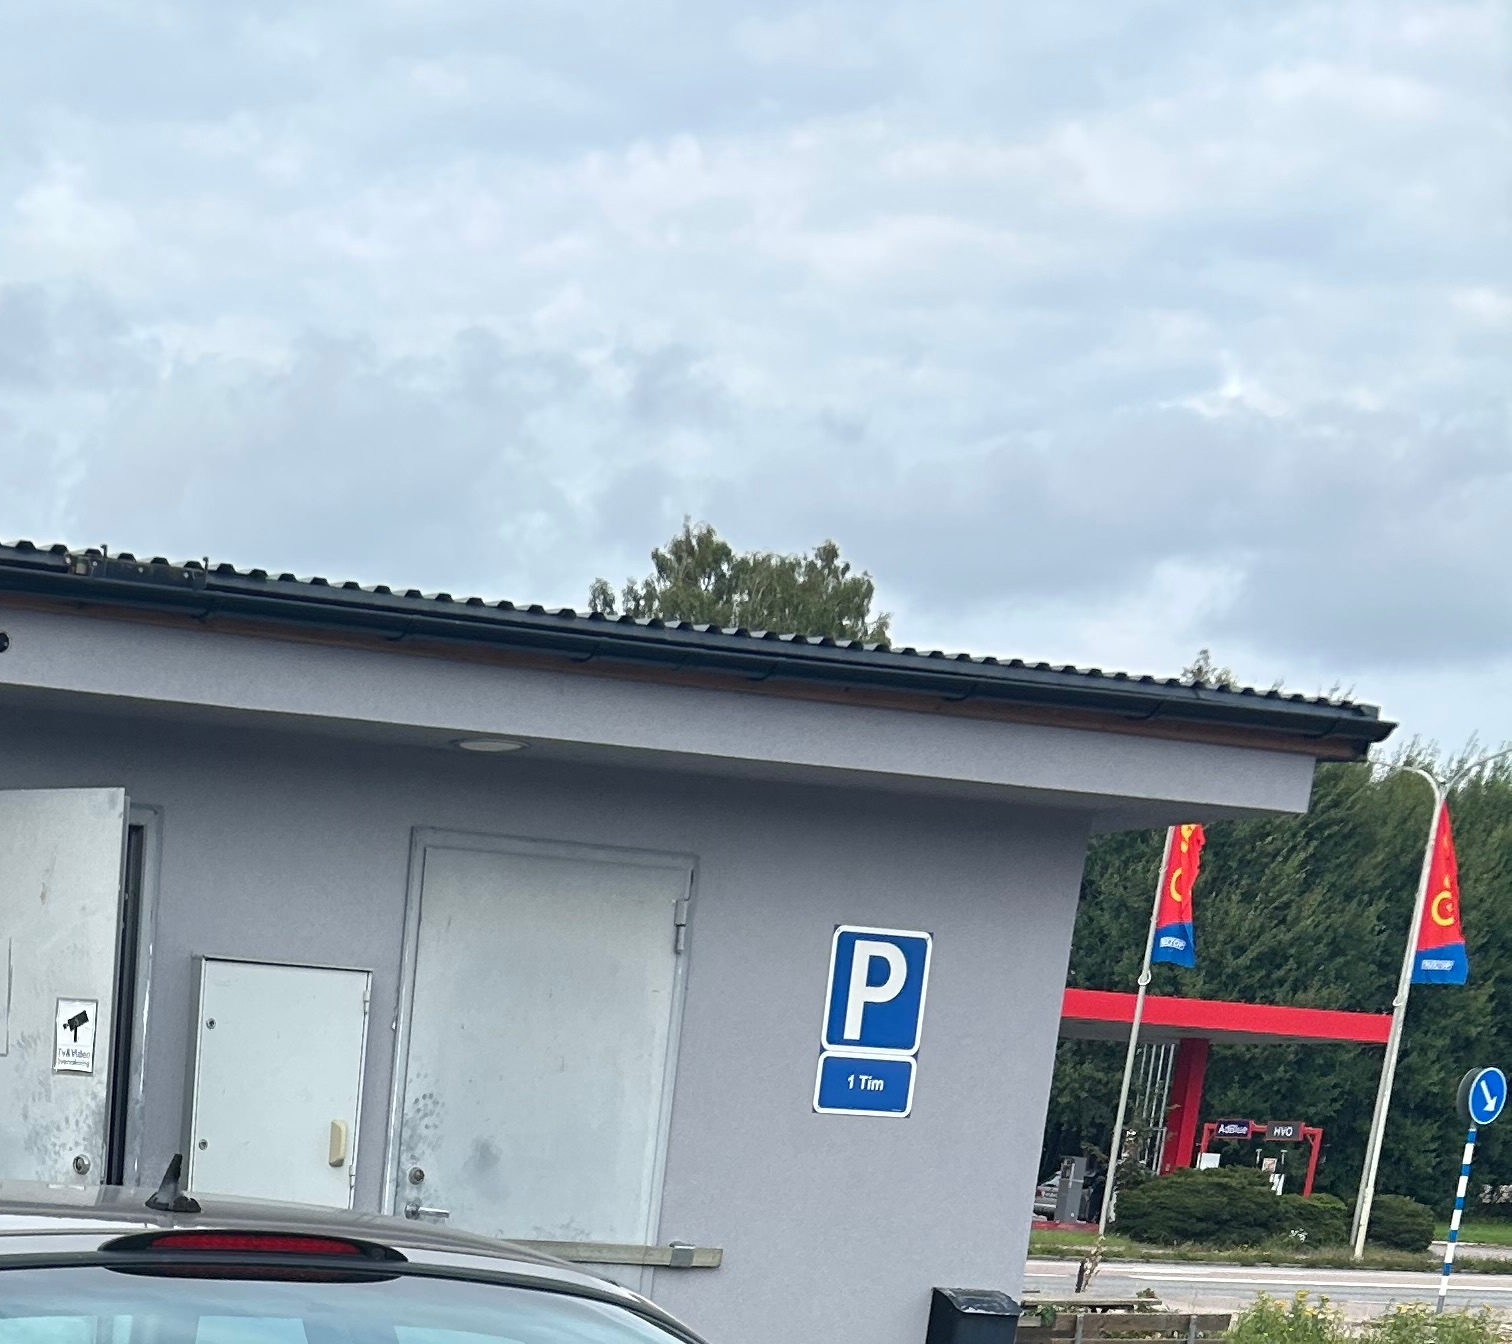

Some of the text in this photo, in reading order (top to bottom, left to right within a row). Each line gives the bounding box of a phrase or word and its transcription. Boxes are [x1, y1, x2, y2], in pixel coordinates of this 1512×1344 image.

[843, 939, 908, 1041] P
[847, 1074, 885, 1092] 1 Tim
[1218, 1124, 1248, 1135] AdBlue
[1273, 1126, 1293, 1137] HVO
